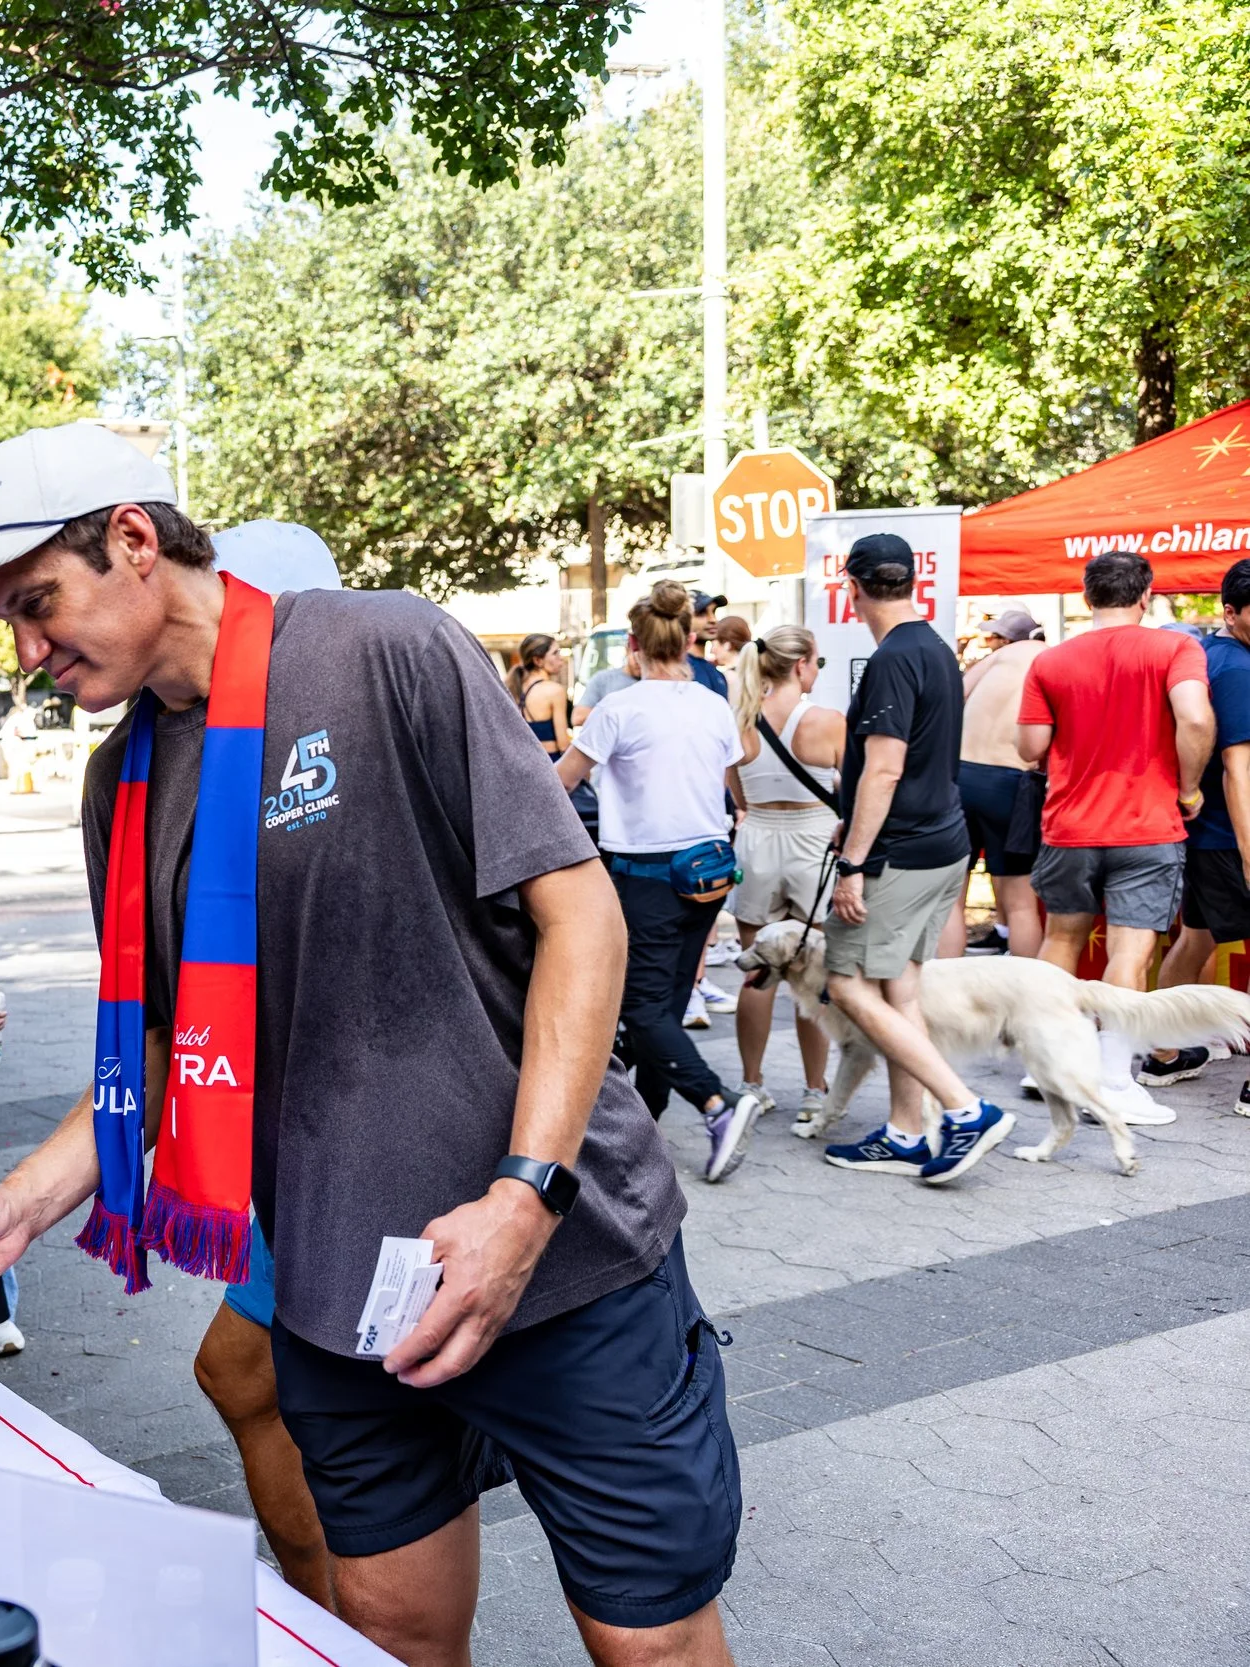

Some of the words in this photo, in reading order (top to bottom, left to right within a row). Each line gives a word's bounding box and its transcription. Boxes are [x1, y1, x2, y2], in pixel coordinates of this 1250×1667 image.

[719, 487, 825, 543] STOP
[824, 580, 935, 624] TAS
[265, 806, 304, 829] COOPER
[304, 794, 340, 814] CLINIC
[286, 820, 303, 832] est.
[304, 811, 327, 825] 1970
[175, 1024, 212, 1047] elob
